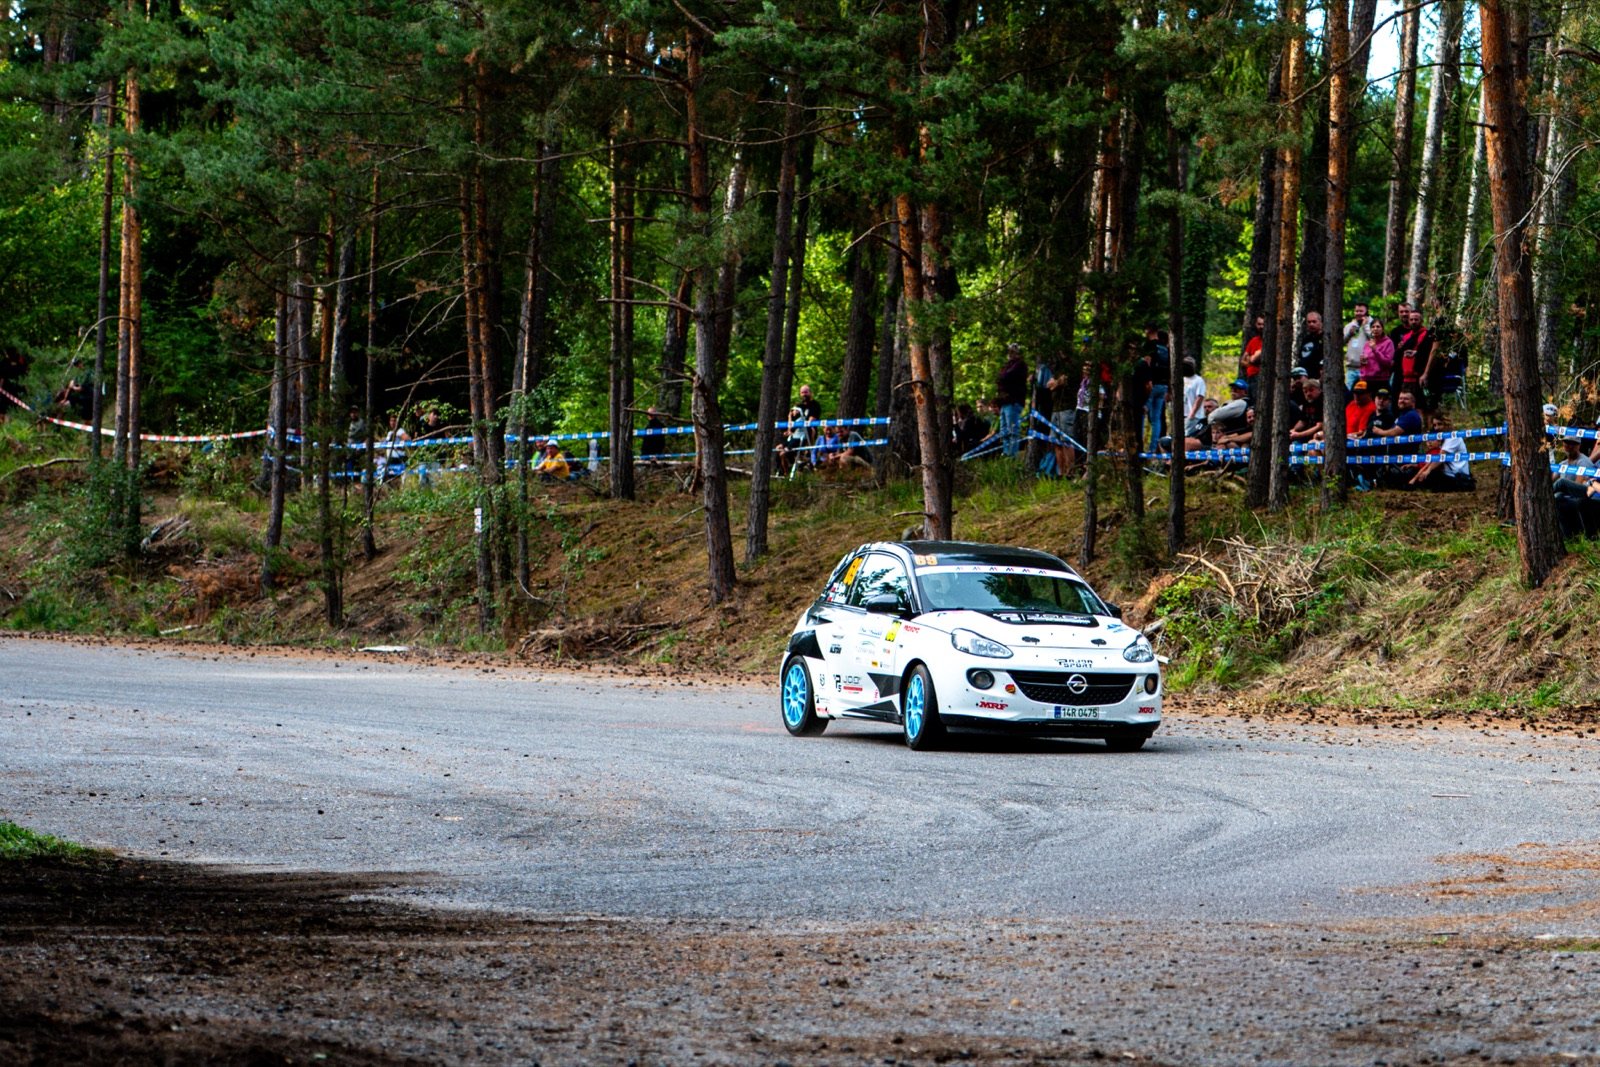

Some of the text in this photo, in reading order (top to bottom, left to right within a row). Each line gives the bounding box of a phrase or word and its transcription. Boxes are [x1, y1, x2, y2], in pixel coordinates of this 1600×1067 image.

[979, 701, 1009, 710] MRF
[1062, 707, 1098, 718] 14R 0475
